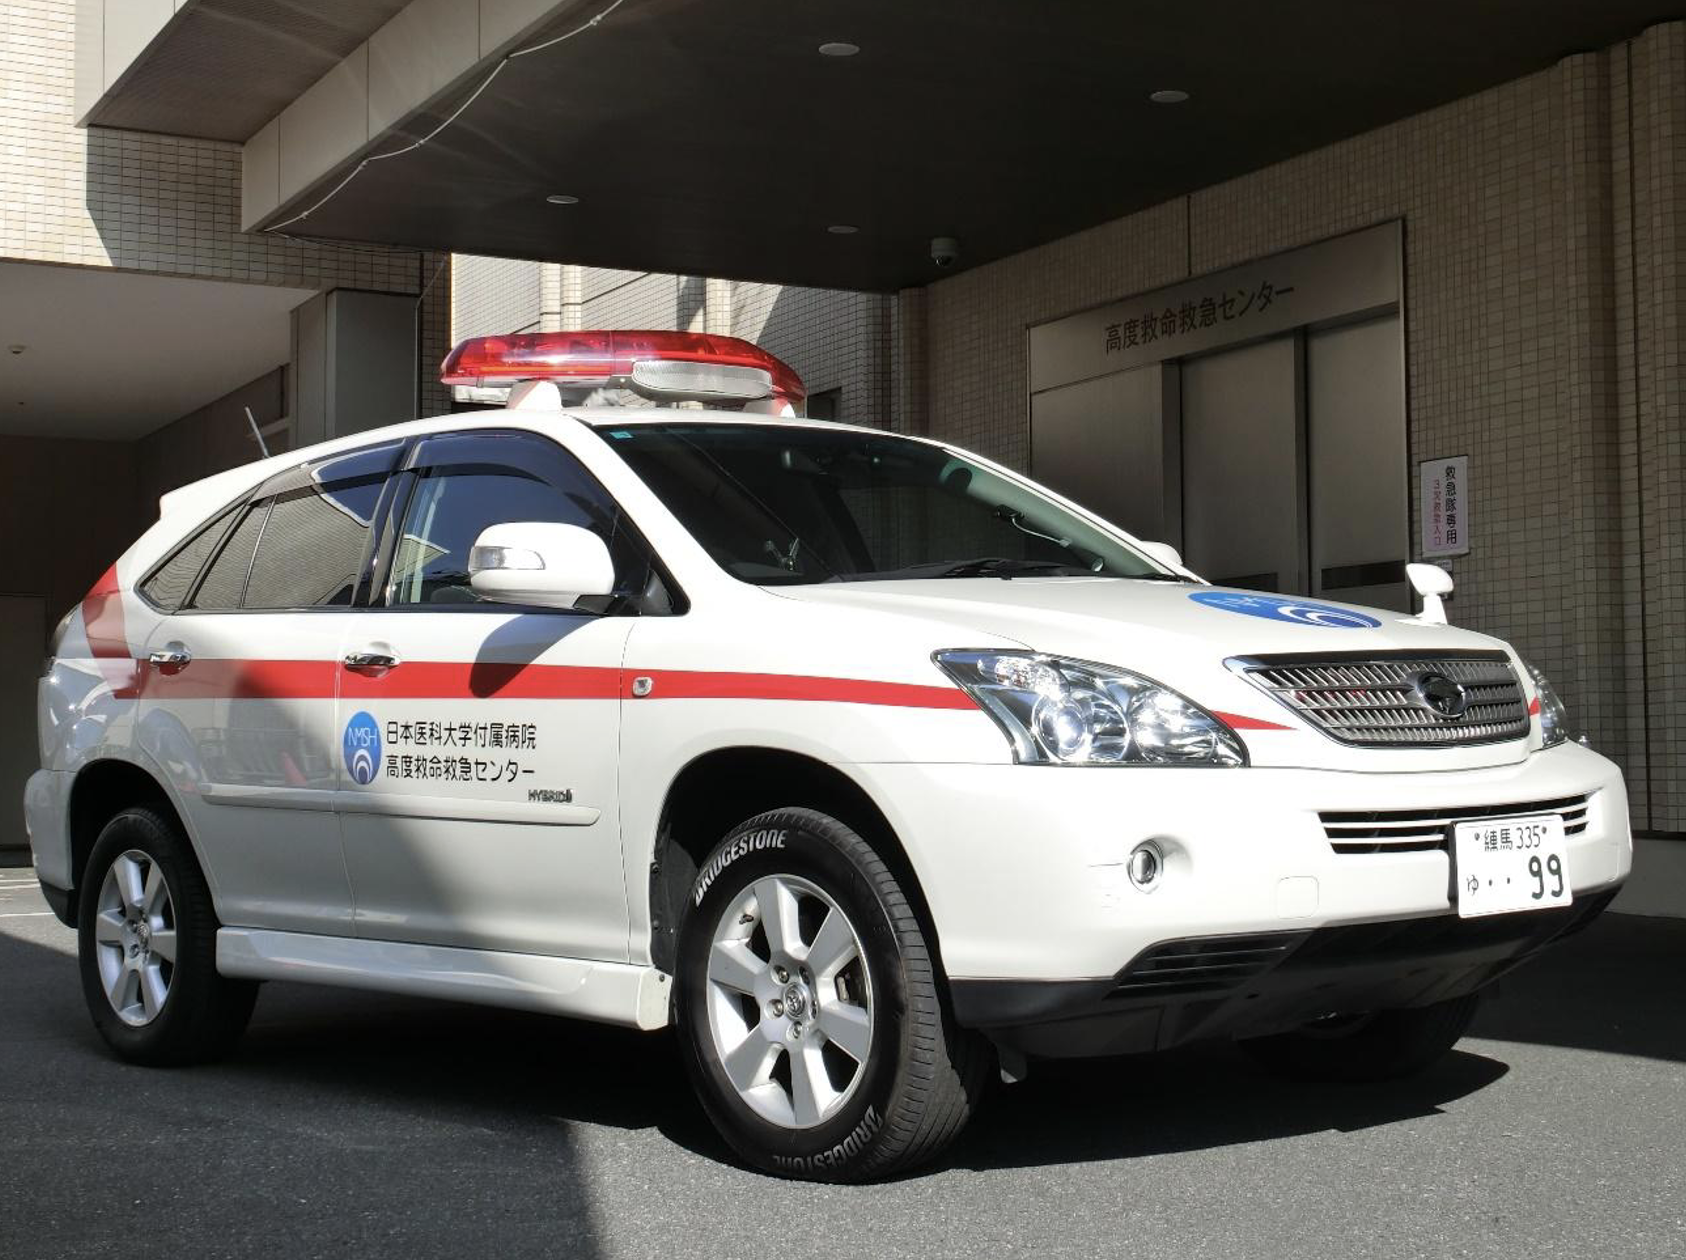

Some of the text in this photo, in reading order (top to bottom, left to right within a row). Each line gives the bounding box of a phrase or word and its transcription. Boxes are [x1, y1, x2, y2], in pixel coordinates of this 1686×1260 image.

[1105, 281, 1294, 355] 高度救命救急センター
[1445, 465, 1457, 545] 救急隊専用
[348, 727, 378, 747] NMSH
[386, 721, 537, 750] 日本医科大学付属病院
[386, 754, 535, 783] 高度救命救急センター
[1484, 825, 1541, 852] 練馬 335
[693, 829, 788, 907] BRIDGESTONE
[1528, 853, 1564, 900] 99
